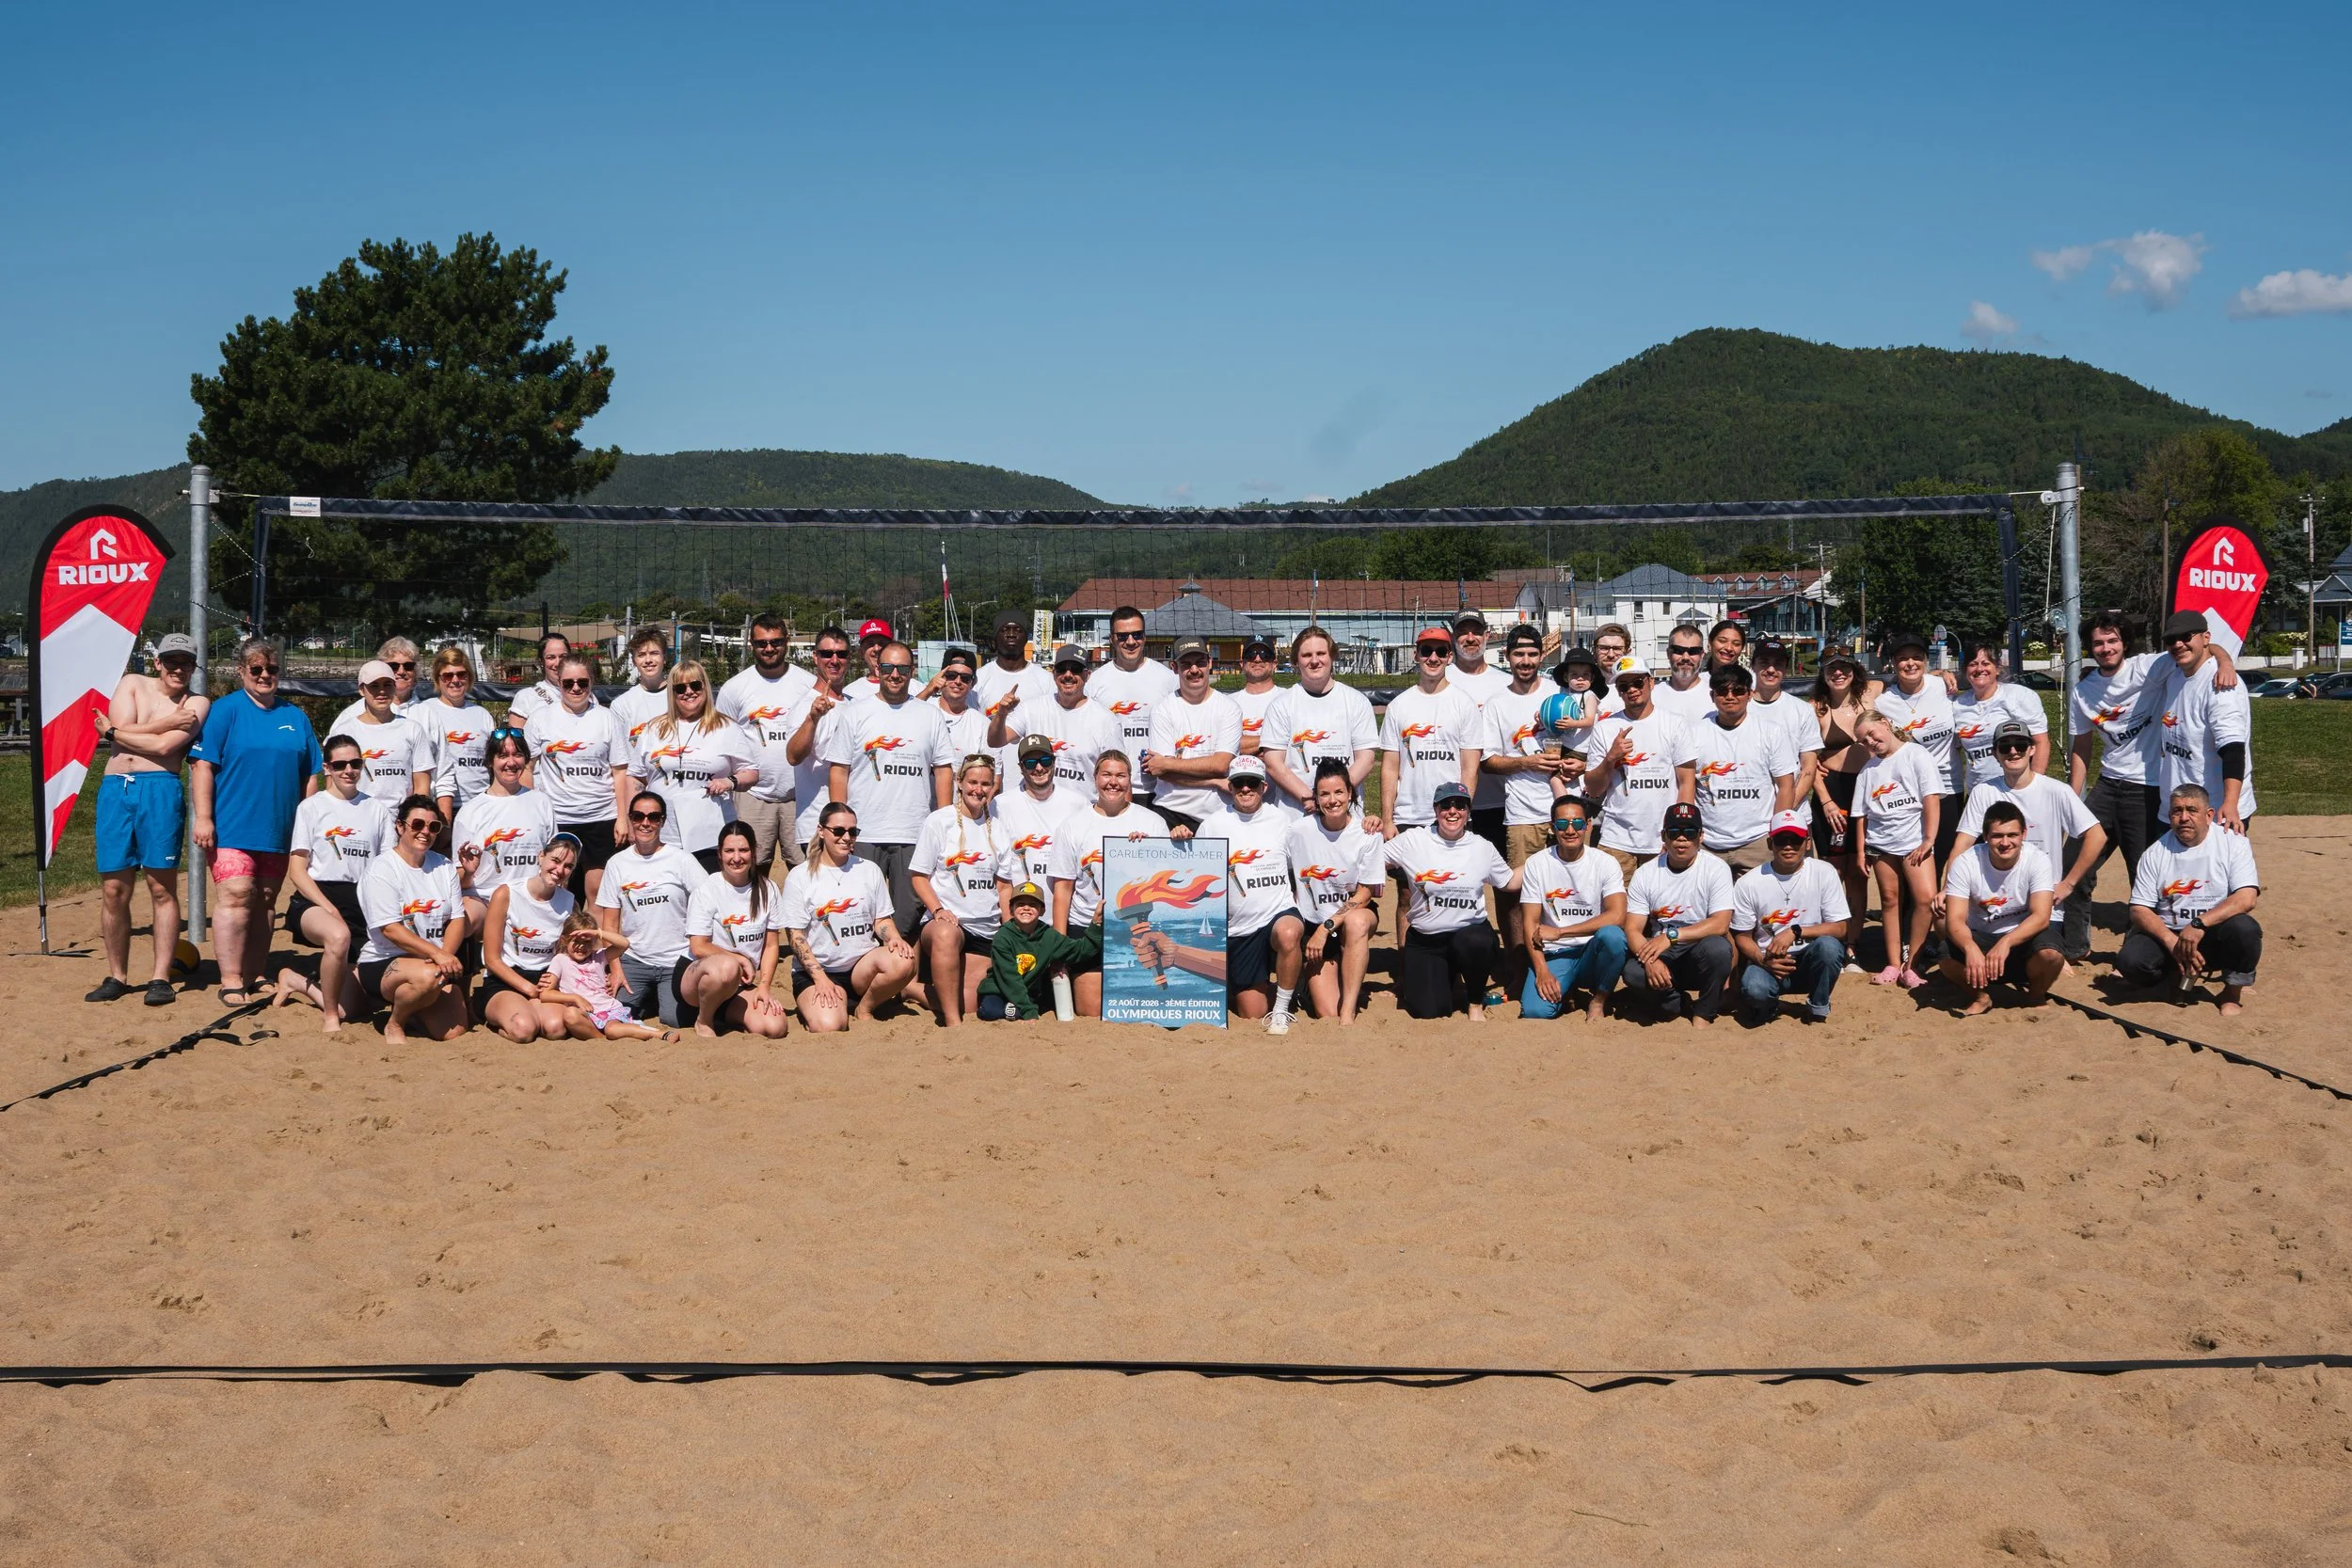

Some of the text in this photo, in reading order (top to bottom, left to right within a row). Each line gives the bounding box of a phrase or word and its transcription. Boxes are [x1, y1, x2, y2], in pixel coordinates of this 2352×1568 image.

[58, 562, 150, 585] RIOUX
[2189, 567, 2256, 592] RIOUX
[769, 731, 787, 740] RIO
[1124, 728, 1149, 736] RIO
[1922, 728, 1953, 743] RIOUX
[1416, 751, 1455, 761] RIOUX
[1975, 747, 1994, 759] RIO
[2166, 741, 2192, 760] RIOUX
[374, 768, 406, 776] RIOUX
[566, 767, 603, 777] RIOUX
[884, 765, 923, 777] RIOUX
[1055, 768, 1085, 782] IOUX
[1629, 779, 1669, 789] RIOUX
[1718, 788, 1760, 800] RIOUX
[1887, 796, 1917, 810] RIOUX
[342, 847, 371, 858] RIOUX
[1109, 848, 1222, 860] CARLETON-SUR-MER
[503, 855, 539, 866] RIOU
[968, 879, 996, 890] RIOU
[1247, 875, 1286, 889] RIOUX
[637, 895, 669, 907] RIOUX
[1435, 896, 1477, 910] RIOUX
[1561, 908, 1593, 916] RIOUX
[841, 923, 874, 938] RIOUX
[1188, 999, 1219, 1007] ÉDITION
[1107, 1009, 1220, 1020] OLYMPIQUES RIOUX
